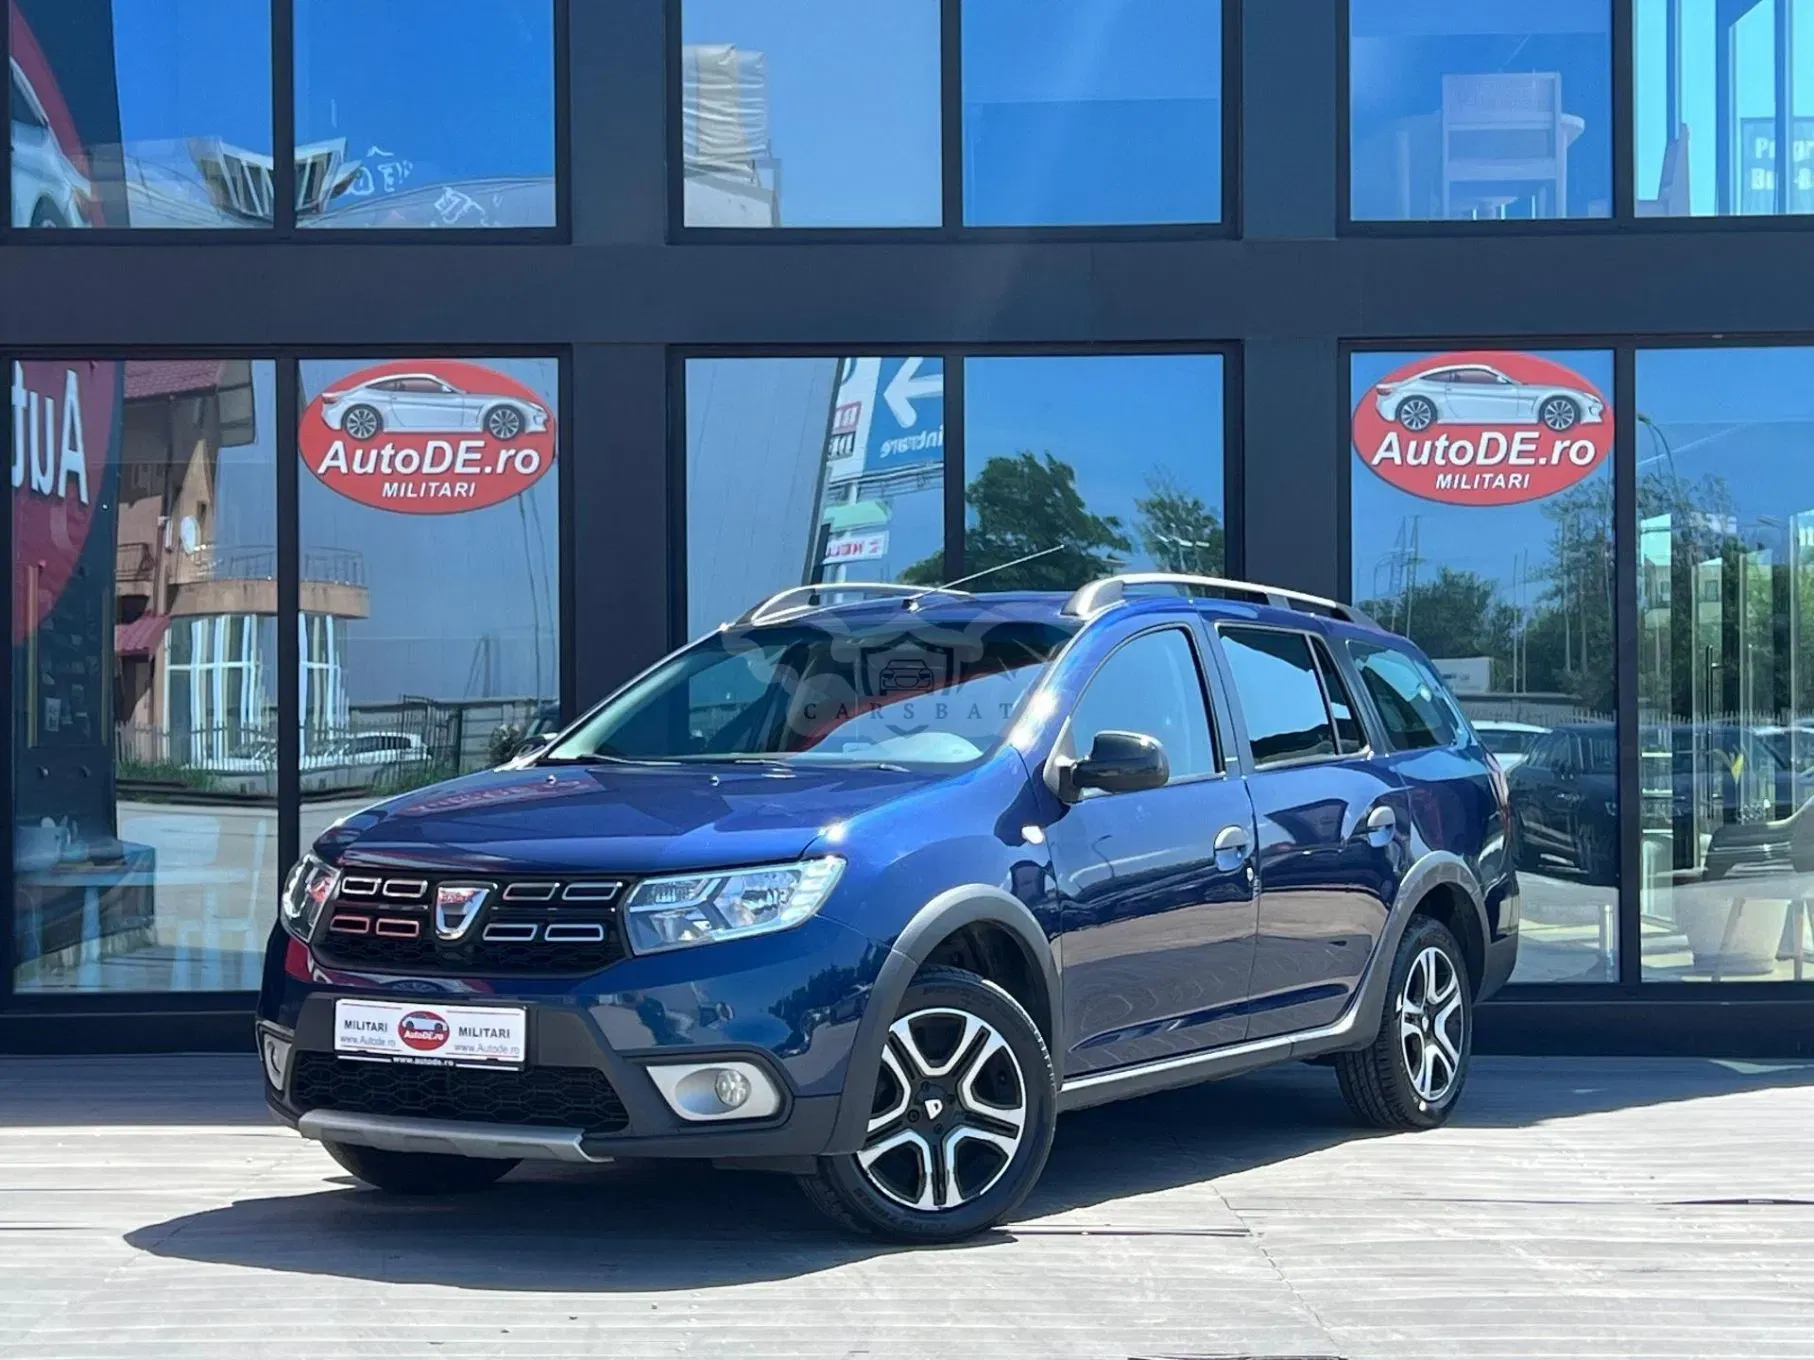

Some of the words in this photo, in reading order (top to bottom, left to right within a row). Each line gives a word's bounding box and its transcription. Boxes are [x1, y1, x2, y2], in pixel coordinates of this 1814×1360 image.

[317, 439, 541, 477] AutoDE.ro
[1371, 430, 1597, 468] AutoDE.ro
[382, 481, 477, 499] MILITARI
[1435, 472, 1530, 490] MILITARI
[343, 1019, 389, 1033] MILITARI
[457, 1026, 512, 1039] MILITARI
